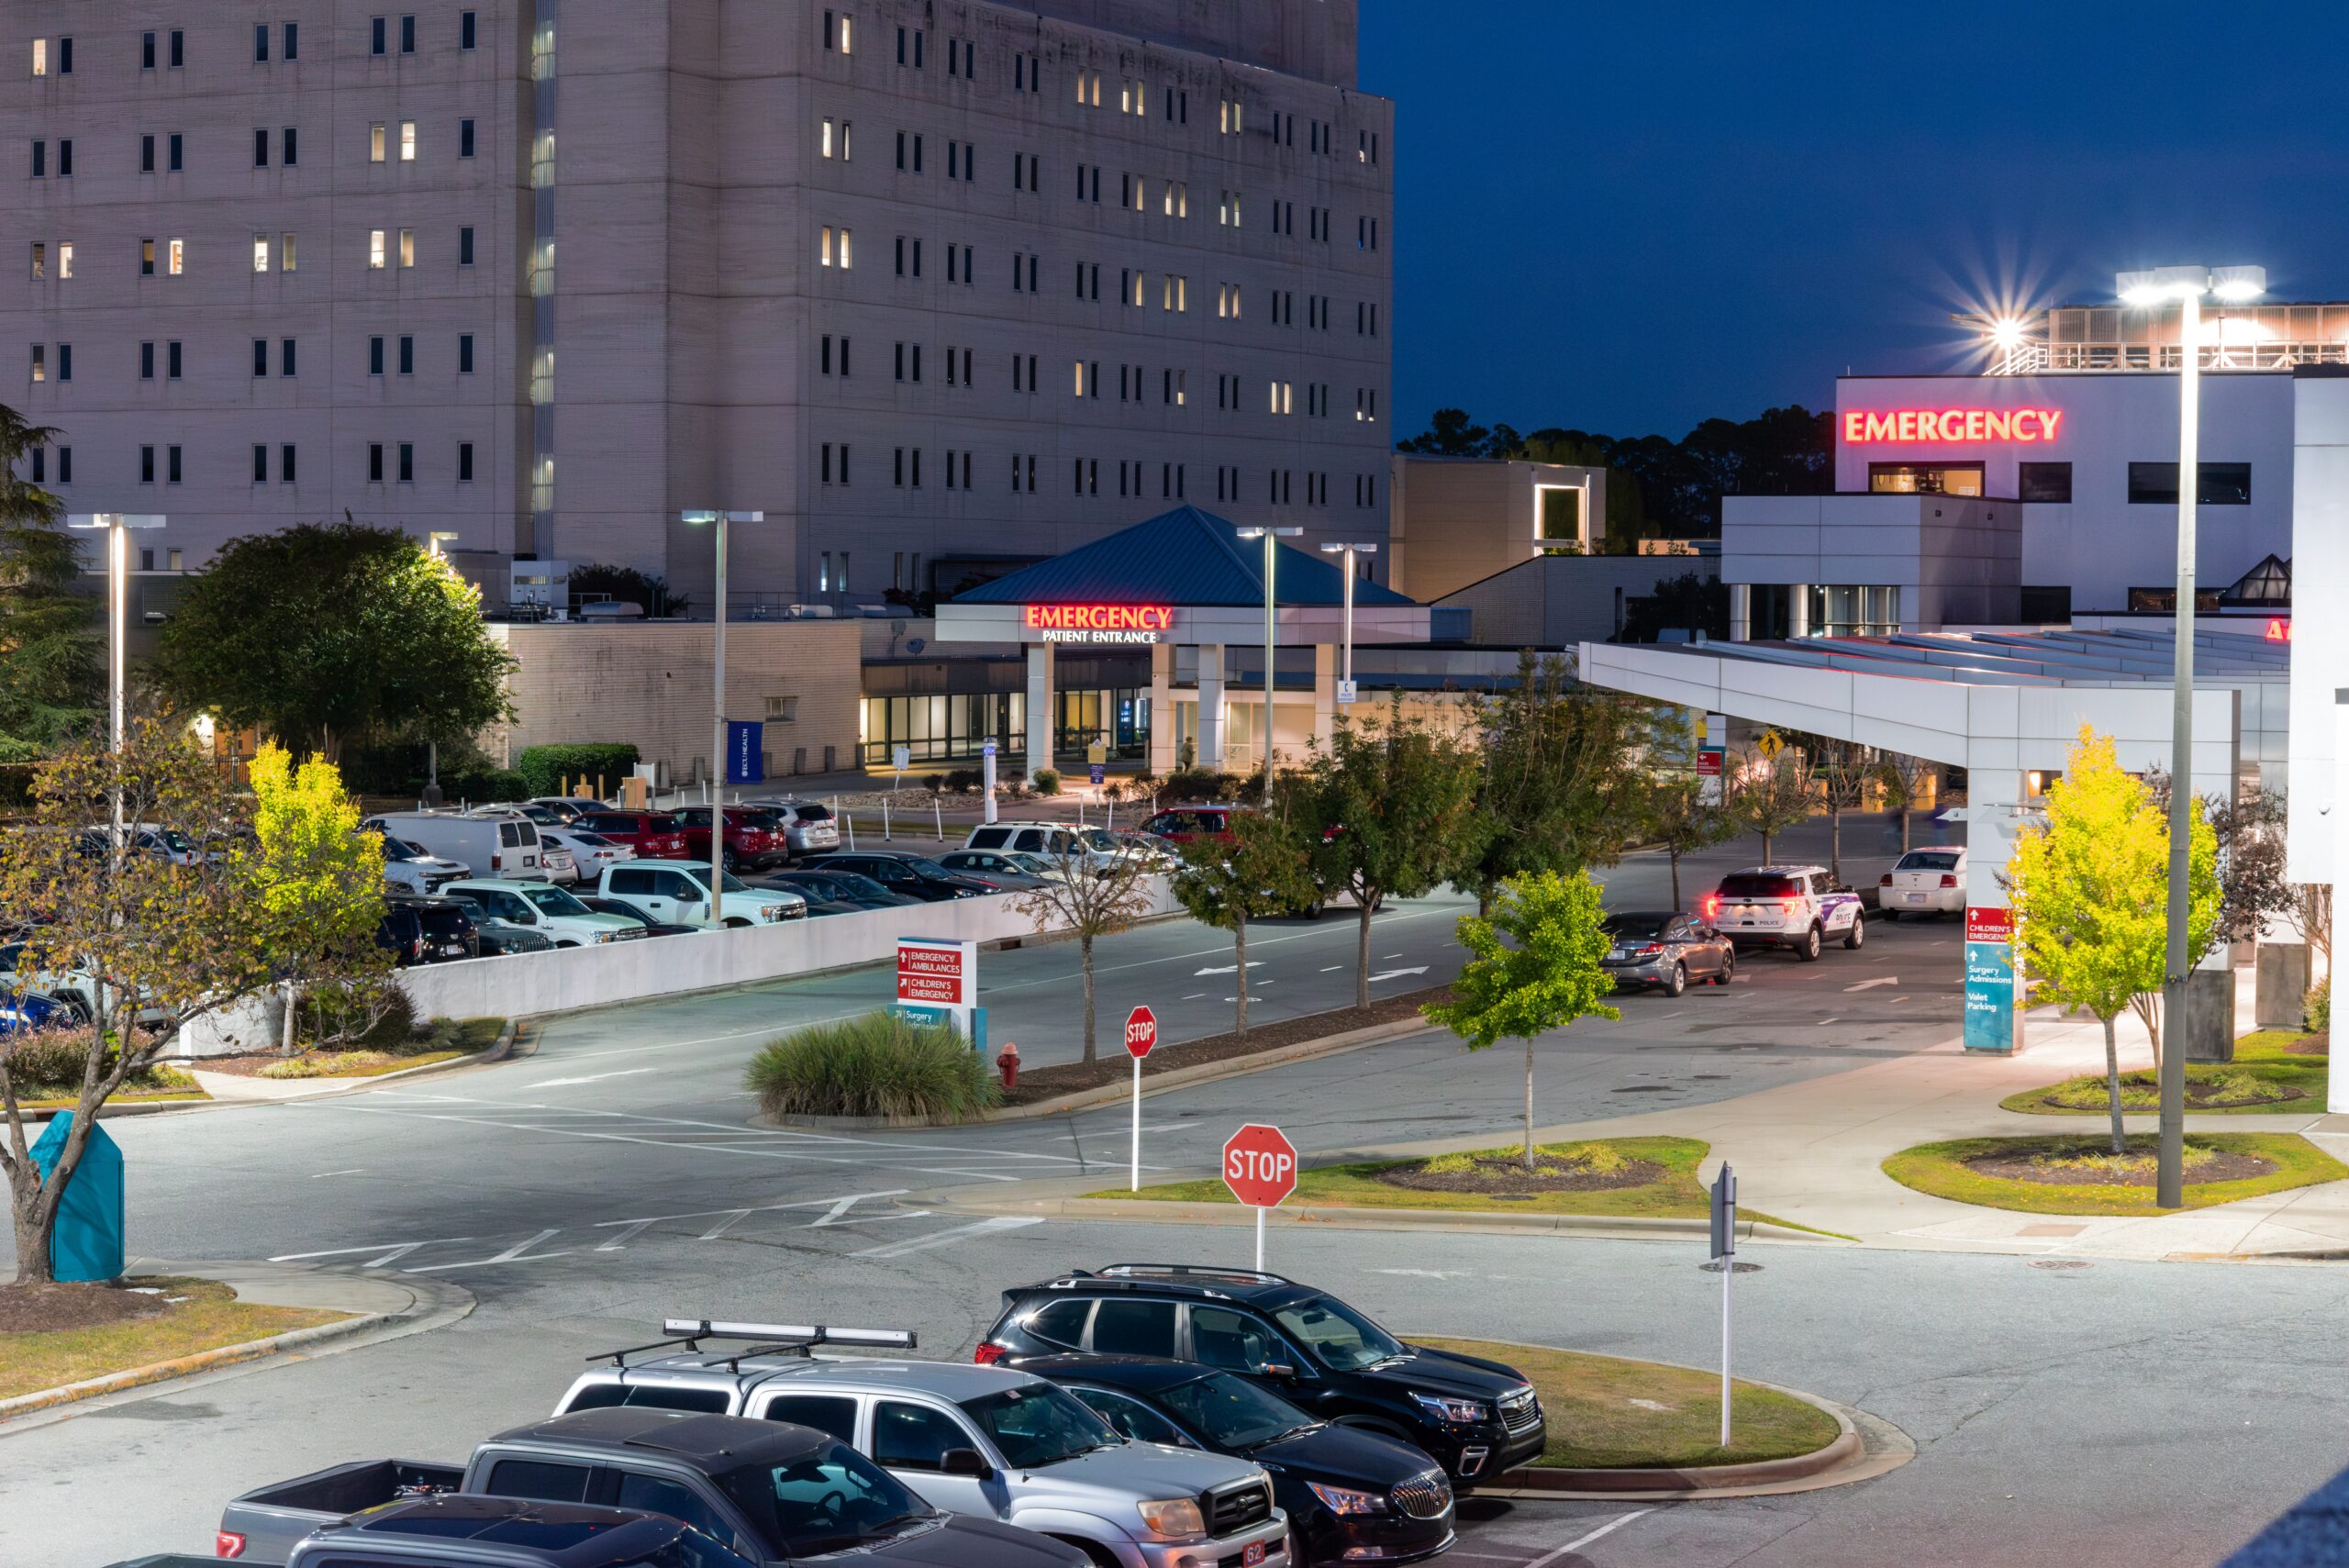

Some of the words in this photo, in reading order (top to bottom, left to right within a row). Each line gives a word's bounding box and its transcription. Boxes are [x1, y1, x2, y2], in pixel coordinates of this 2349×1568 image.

[1845, 410, 2062, 441] EMERGENCY
[1027, 606, 1172, 629] EMERGENCY
[1042, 630, 1089, 642] PATIENT
[1092, 631, 1156, 643] ENTRANCE
[1969, 925, 2010, 933] CHILDREN'S
[1969, 932, 2005, 940] EMERGEN
[911, 951, 955, 963] EMERGENCY/
[911, 962, 960, 973] AMBULANCES
[1968, 965, 1999, 976] Surgery
[911, 978, 951, 990] CHILDREN'S
[1968, 974, 2012, 984] Admissions
[911, 988, 953, 1000] EMERGENCY
[1968, 993, 1988, 1001] Valet
[1967, 1002, 1997, 1012] Parking
[906, 1010, 932, 1022] Surgery
[1127, 1021, 1154, 1043] STOP
[1229, 1149, 1292, 1183] STOP
[1247, 1544, 1262, 1562] 62
